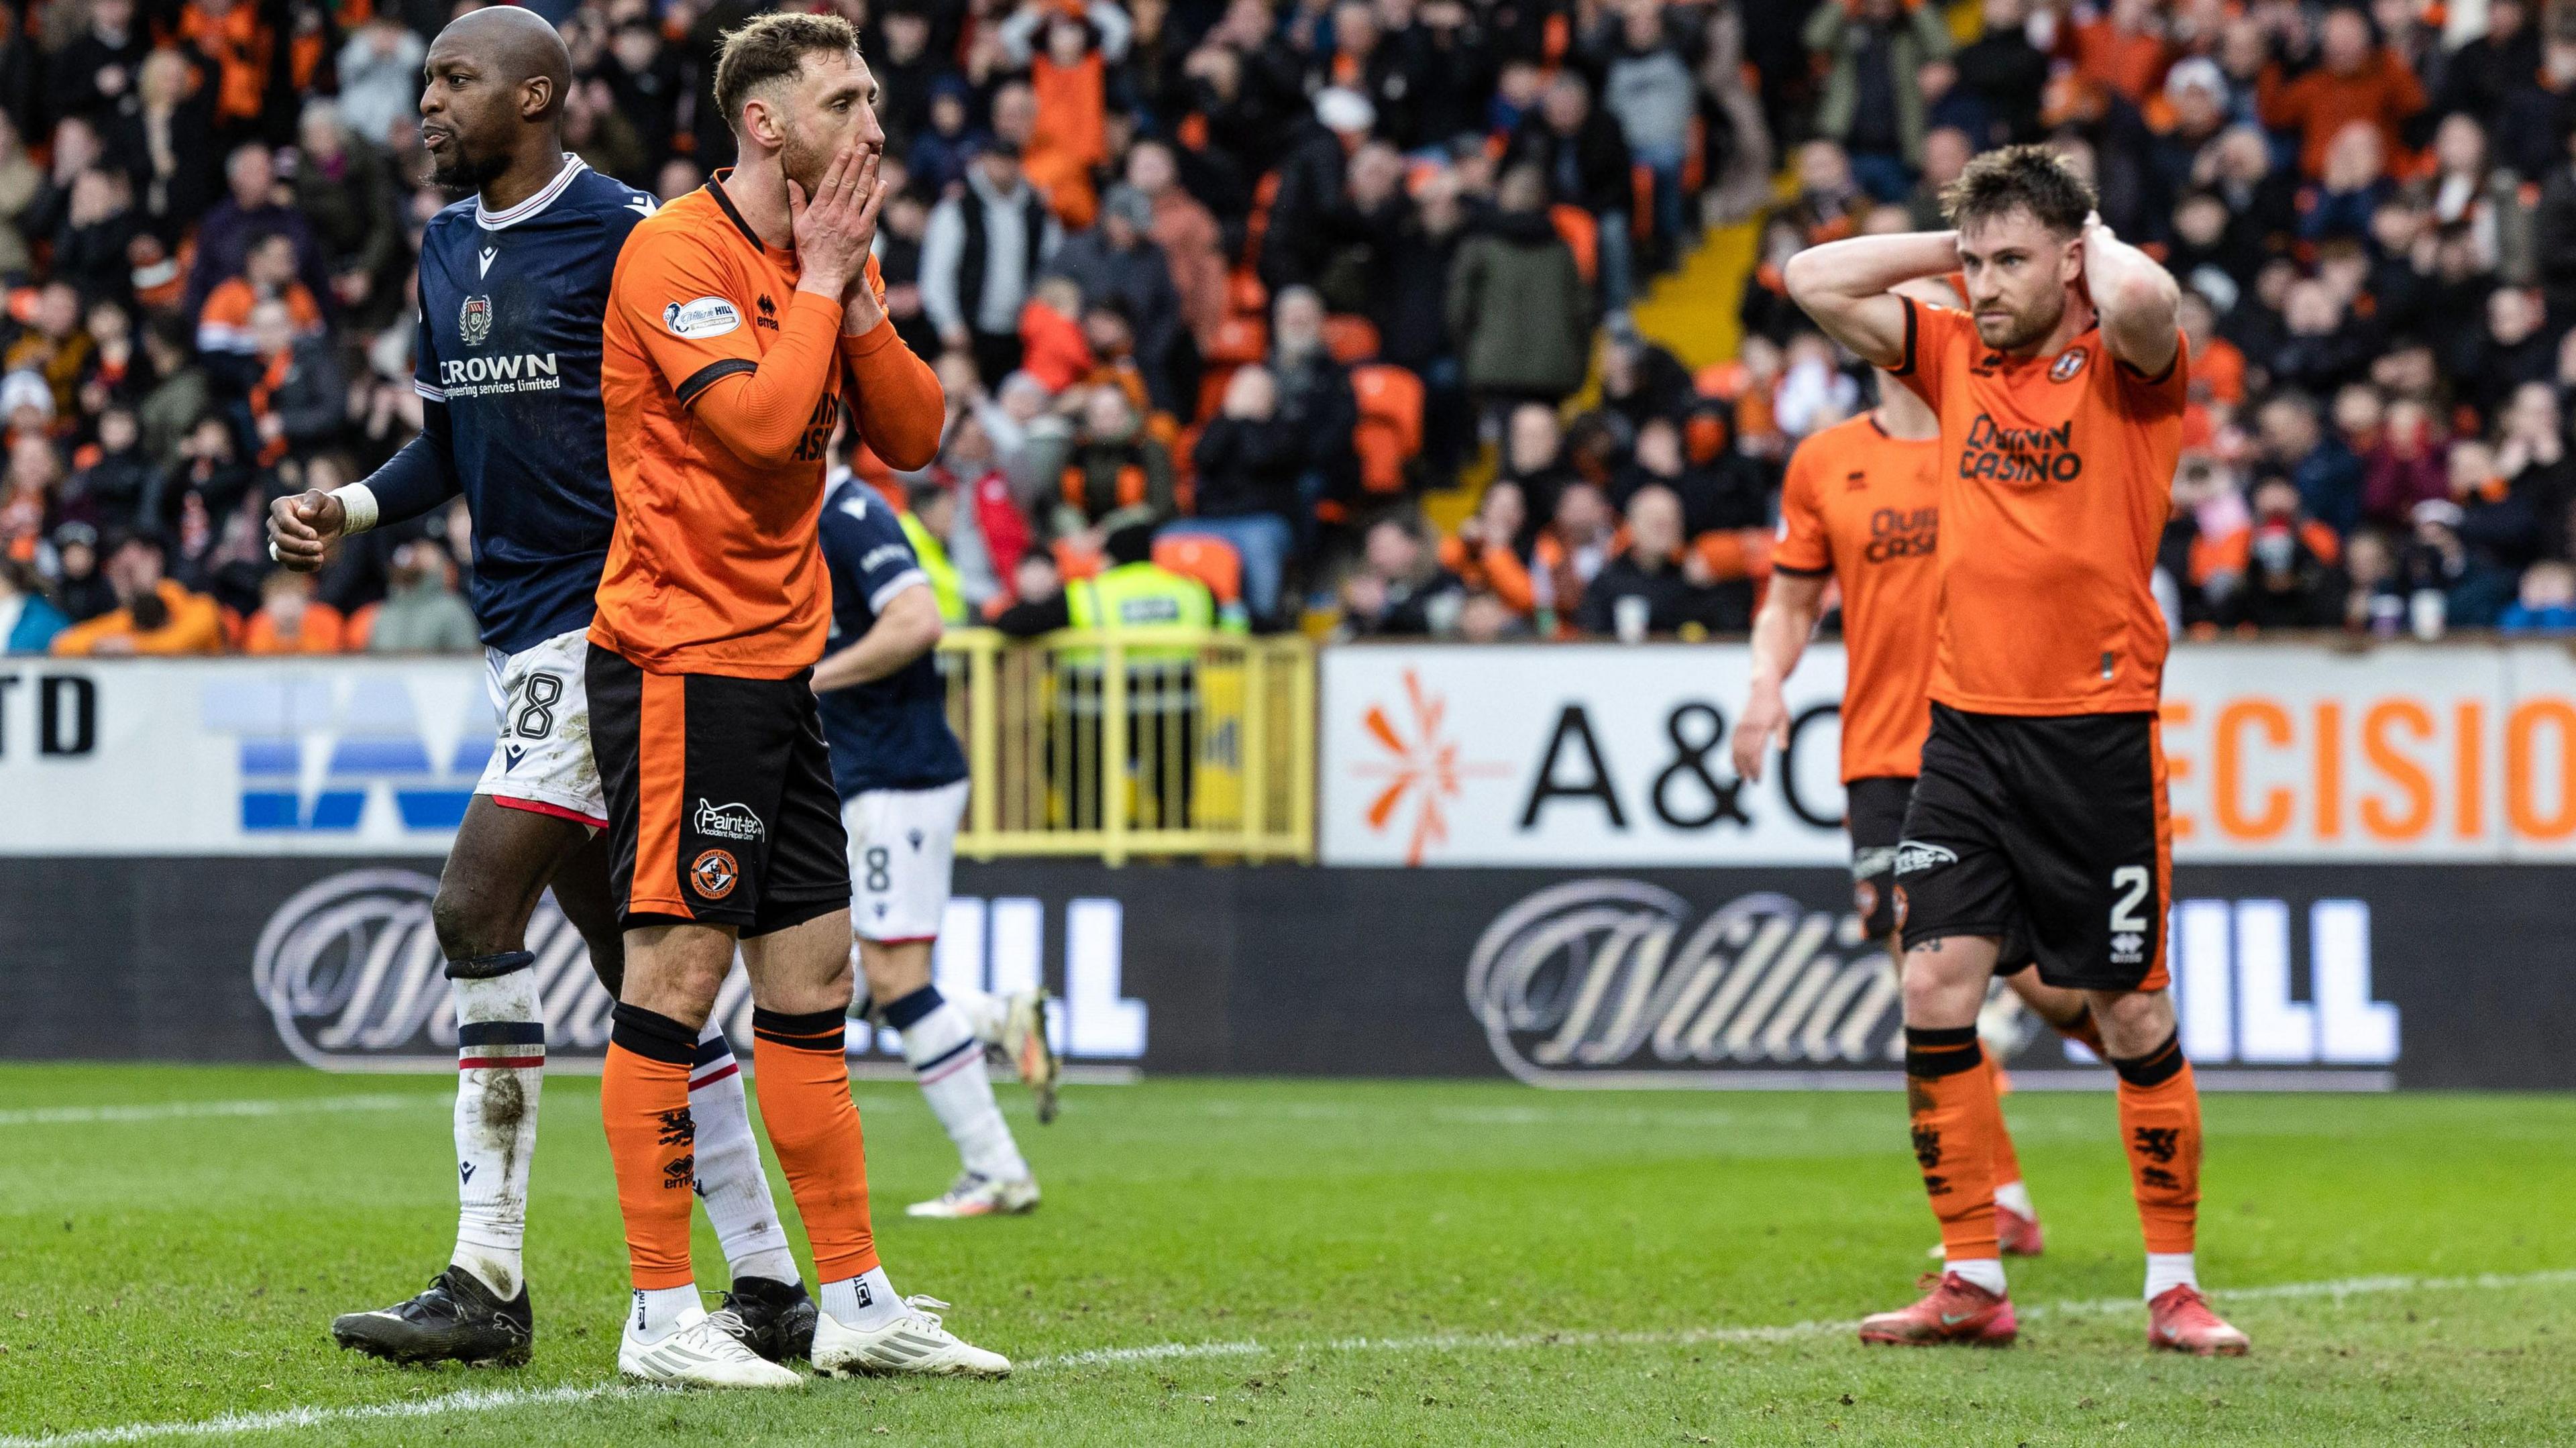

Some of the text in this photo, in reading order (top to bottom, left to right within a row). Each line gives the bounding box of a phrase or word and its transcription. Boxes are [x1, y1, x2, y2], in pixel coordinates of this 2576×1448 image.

[715, 306, 733, 315] HILL
[440, 353, 558, 385] CROWN
[479, 381, 515, 395] services
[517, 376, 560, 392] limited
[1967, 412, 2072, 451] QUINN
[1960, 451, 2082, 483] CASINO
[701, 827, 727, 838] Accident
[728, 830, 743, 840] Repair
[702, 809, 758, 834] Paint-tec
[865, 846, 890, 893] 8
[694, 881, 717, 897] FOOTBALL
[2110, 865, 2149, 932] 2
[1465, 877, 1907, 1091] Willia
